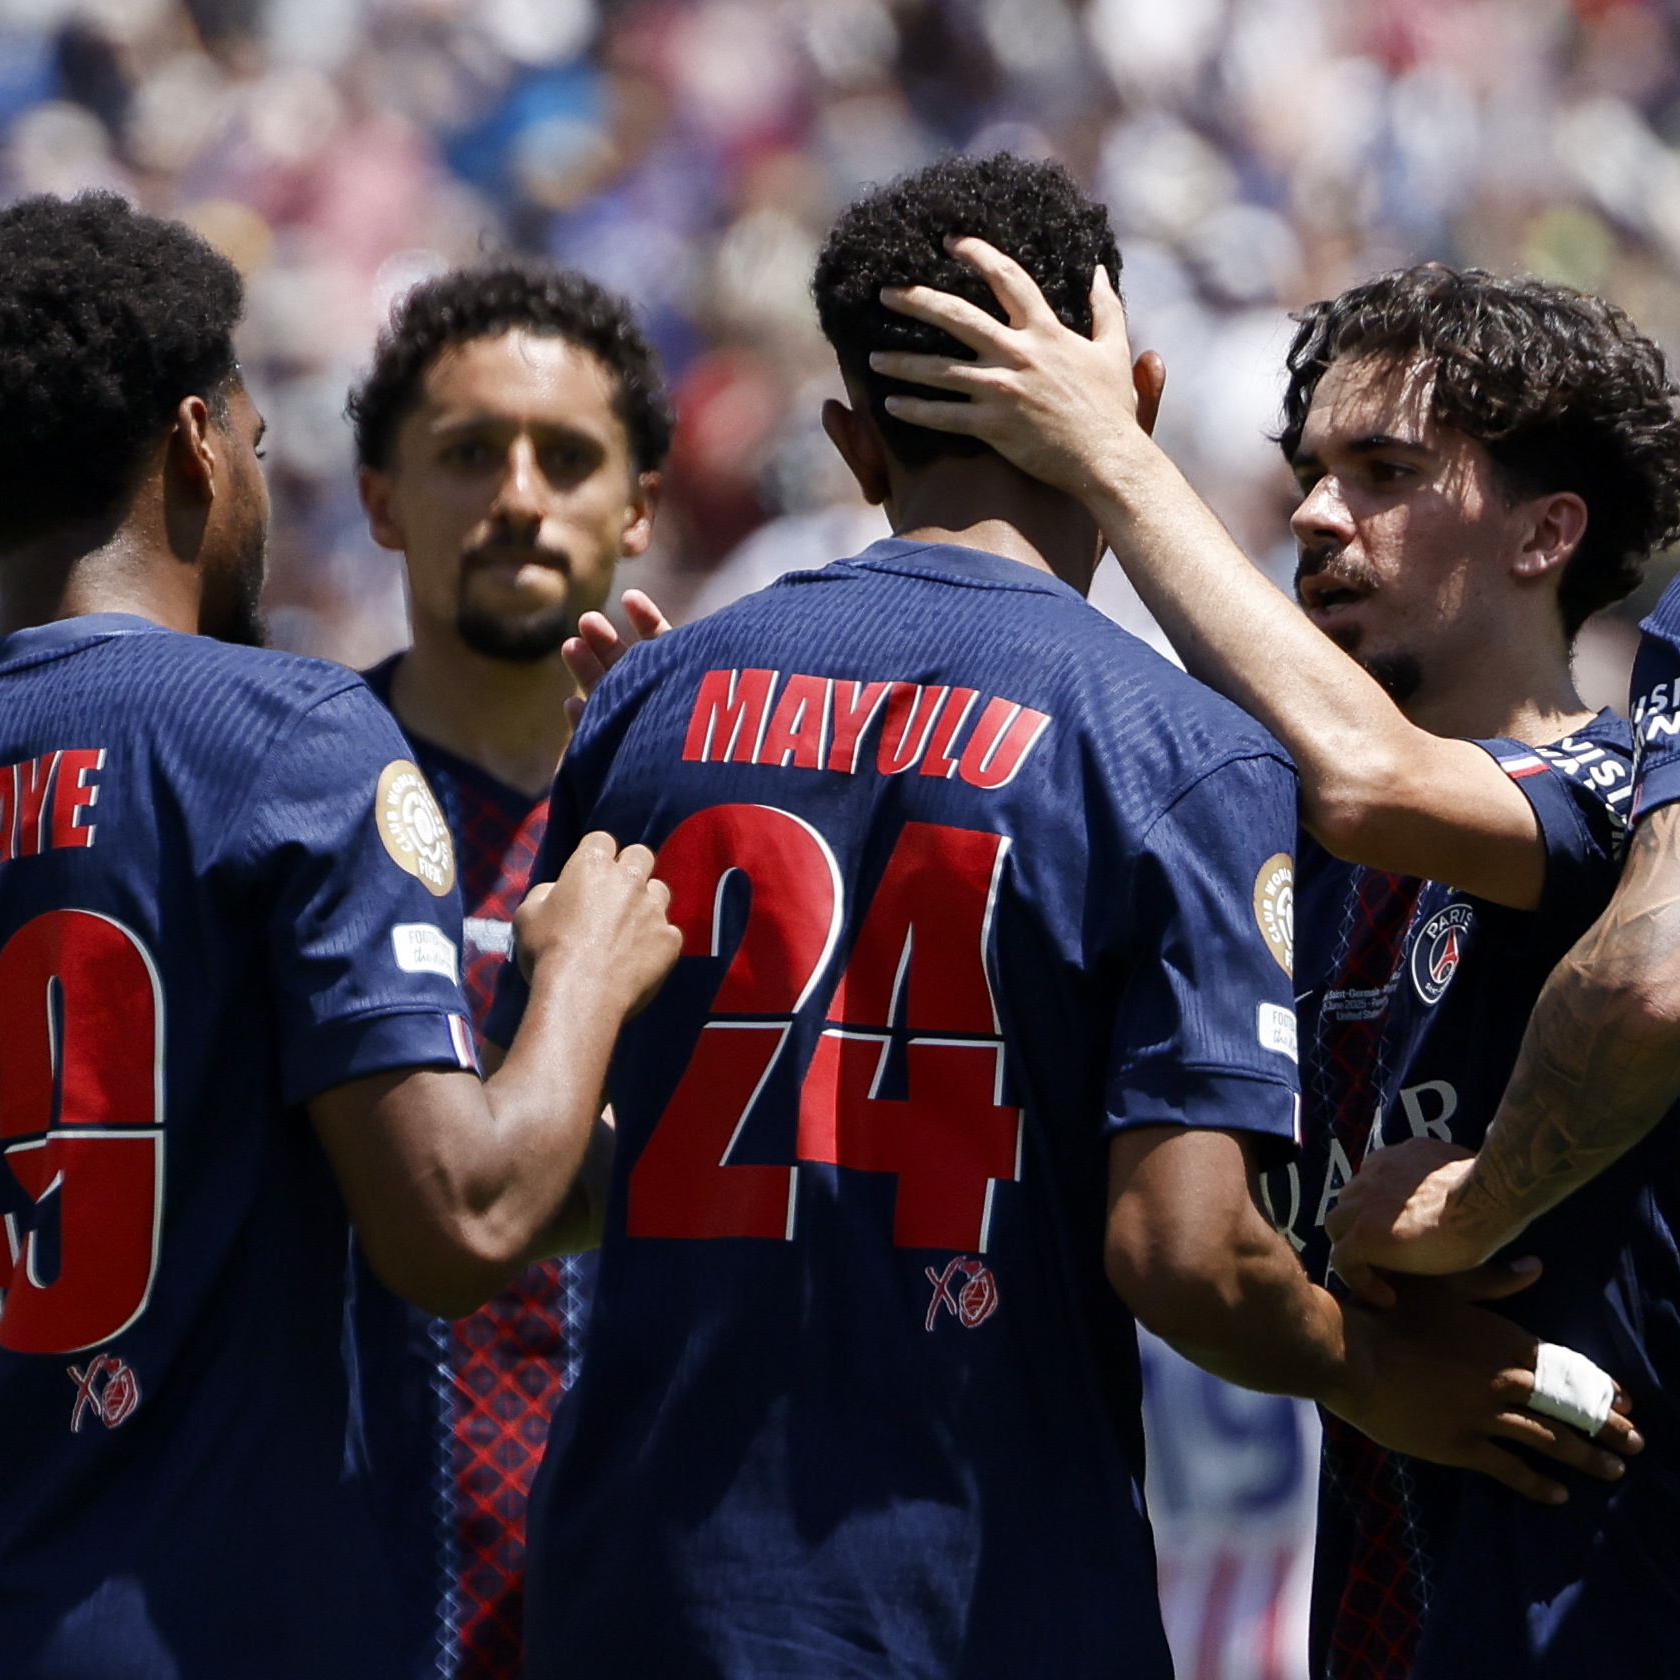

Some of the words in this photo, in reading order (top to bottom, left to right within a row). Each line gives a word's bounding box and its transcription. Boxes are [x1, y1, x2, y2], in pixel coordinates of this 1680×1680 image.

[681, 667, 1053, 790] MAYULU
[417, 856, 445, 887] FIFA
[625, 802, 1025, 1255] 24
